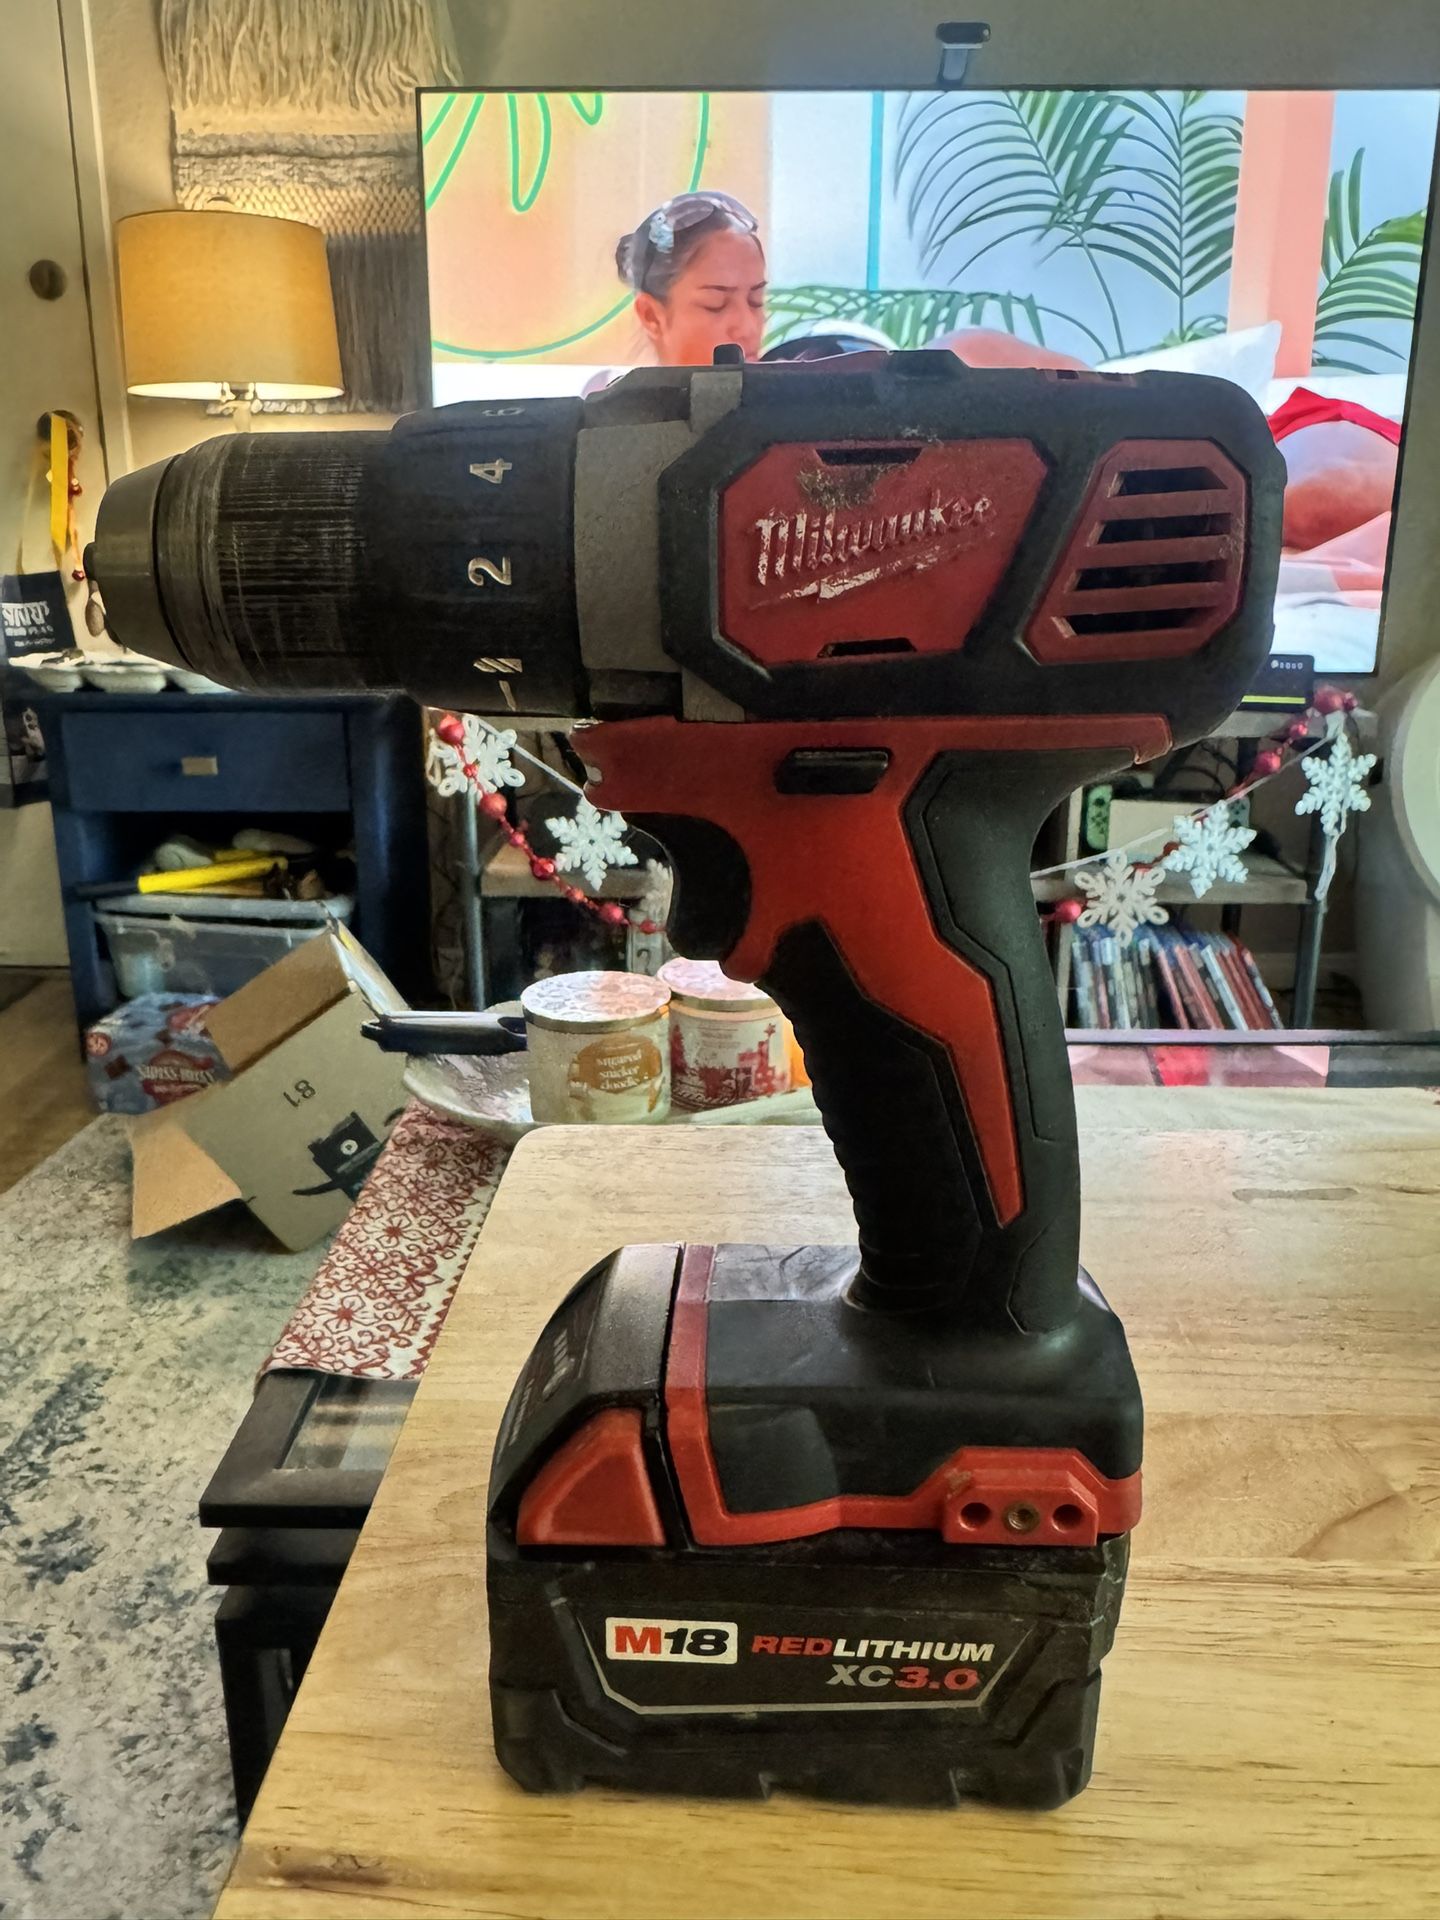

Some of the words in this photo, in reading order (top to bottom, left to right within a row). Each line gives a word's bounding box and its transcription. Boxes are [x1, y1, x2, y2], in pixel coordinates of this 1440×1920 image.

[469, 457, 513, 484] 4
[468, 556, 512, 586] 2
[614, 1625, 730, 1657] M18
[752, 1634, 995, 1662] REDLITHIUM
[826, 1663, 982, 1691] XC3.0
